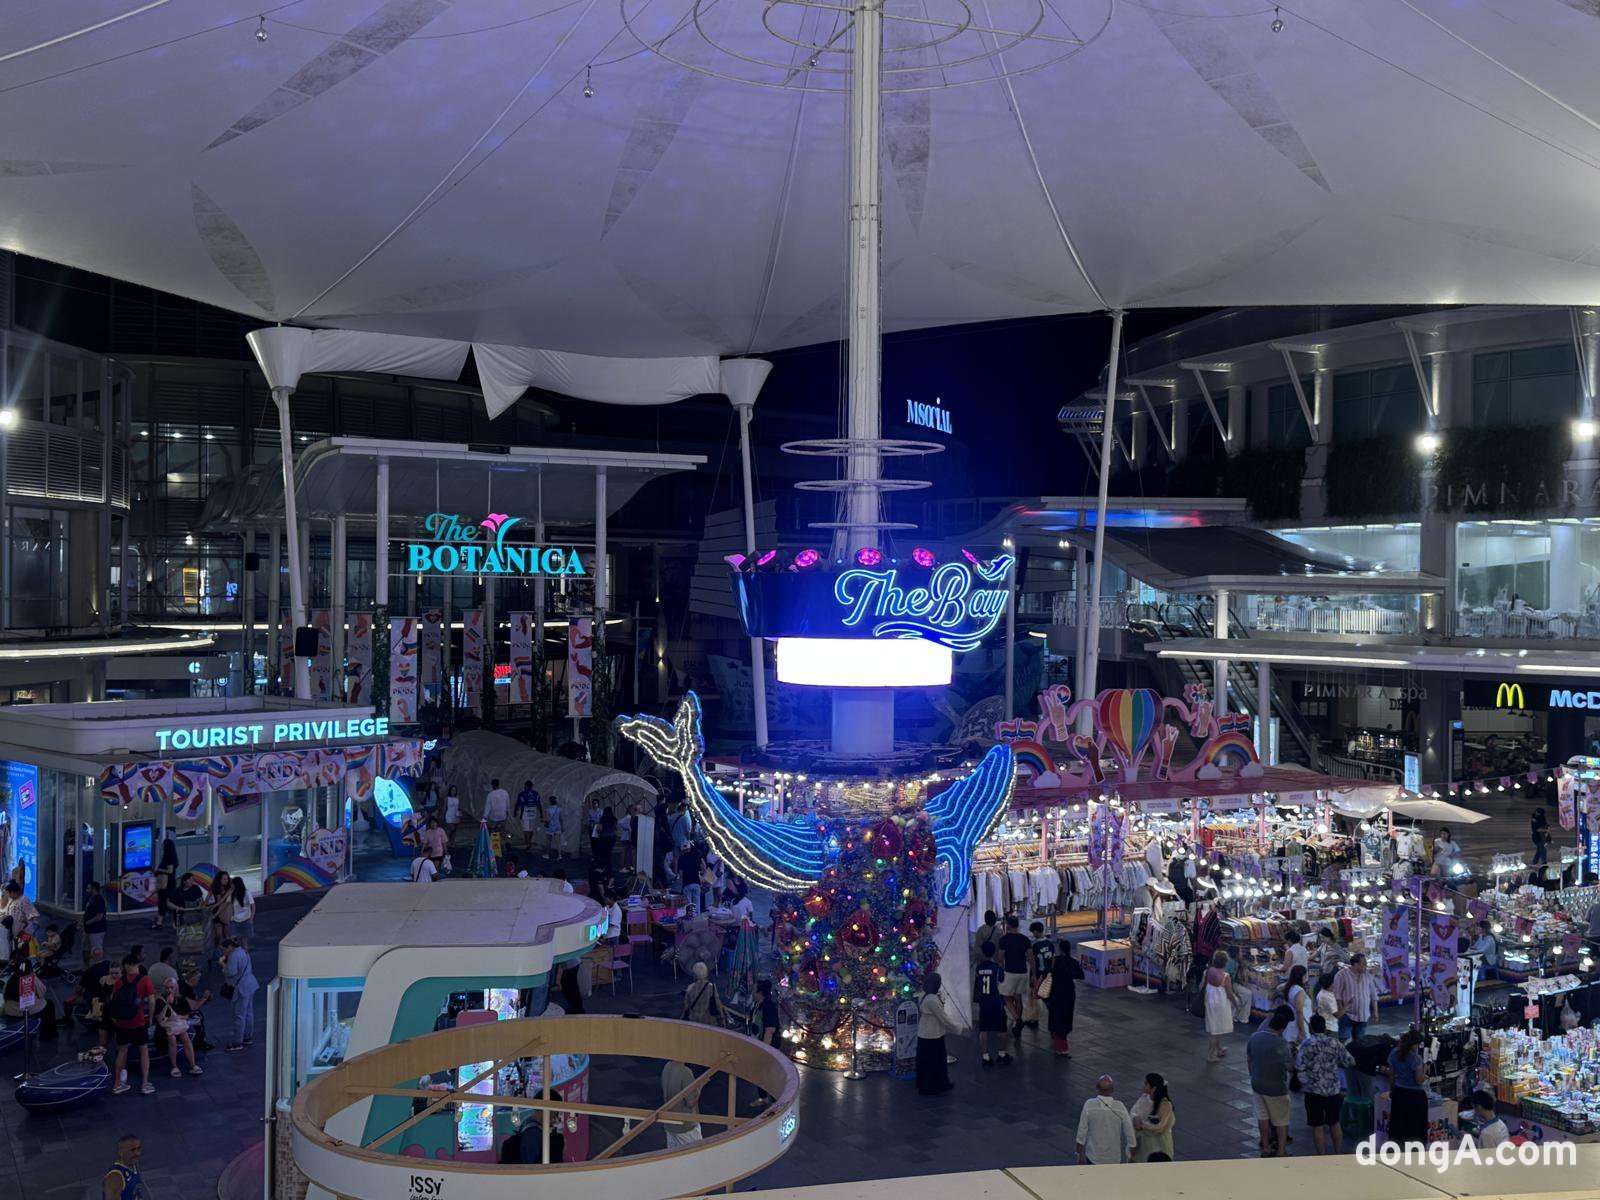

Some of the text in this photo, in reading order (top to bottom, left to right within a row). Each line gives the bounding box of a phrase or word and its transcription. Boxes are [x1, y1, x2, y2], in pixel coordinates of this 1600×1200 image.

[424, 512, 480, 542] The
[407, 543, 587, 575] BOTANICA
[1399, 686, 1428, 704] spa
[155, 717, 389, 750] TOURIST PRIVILEGE
